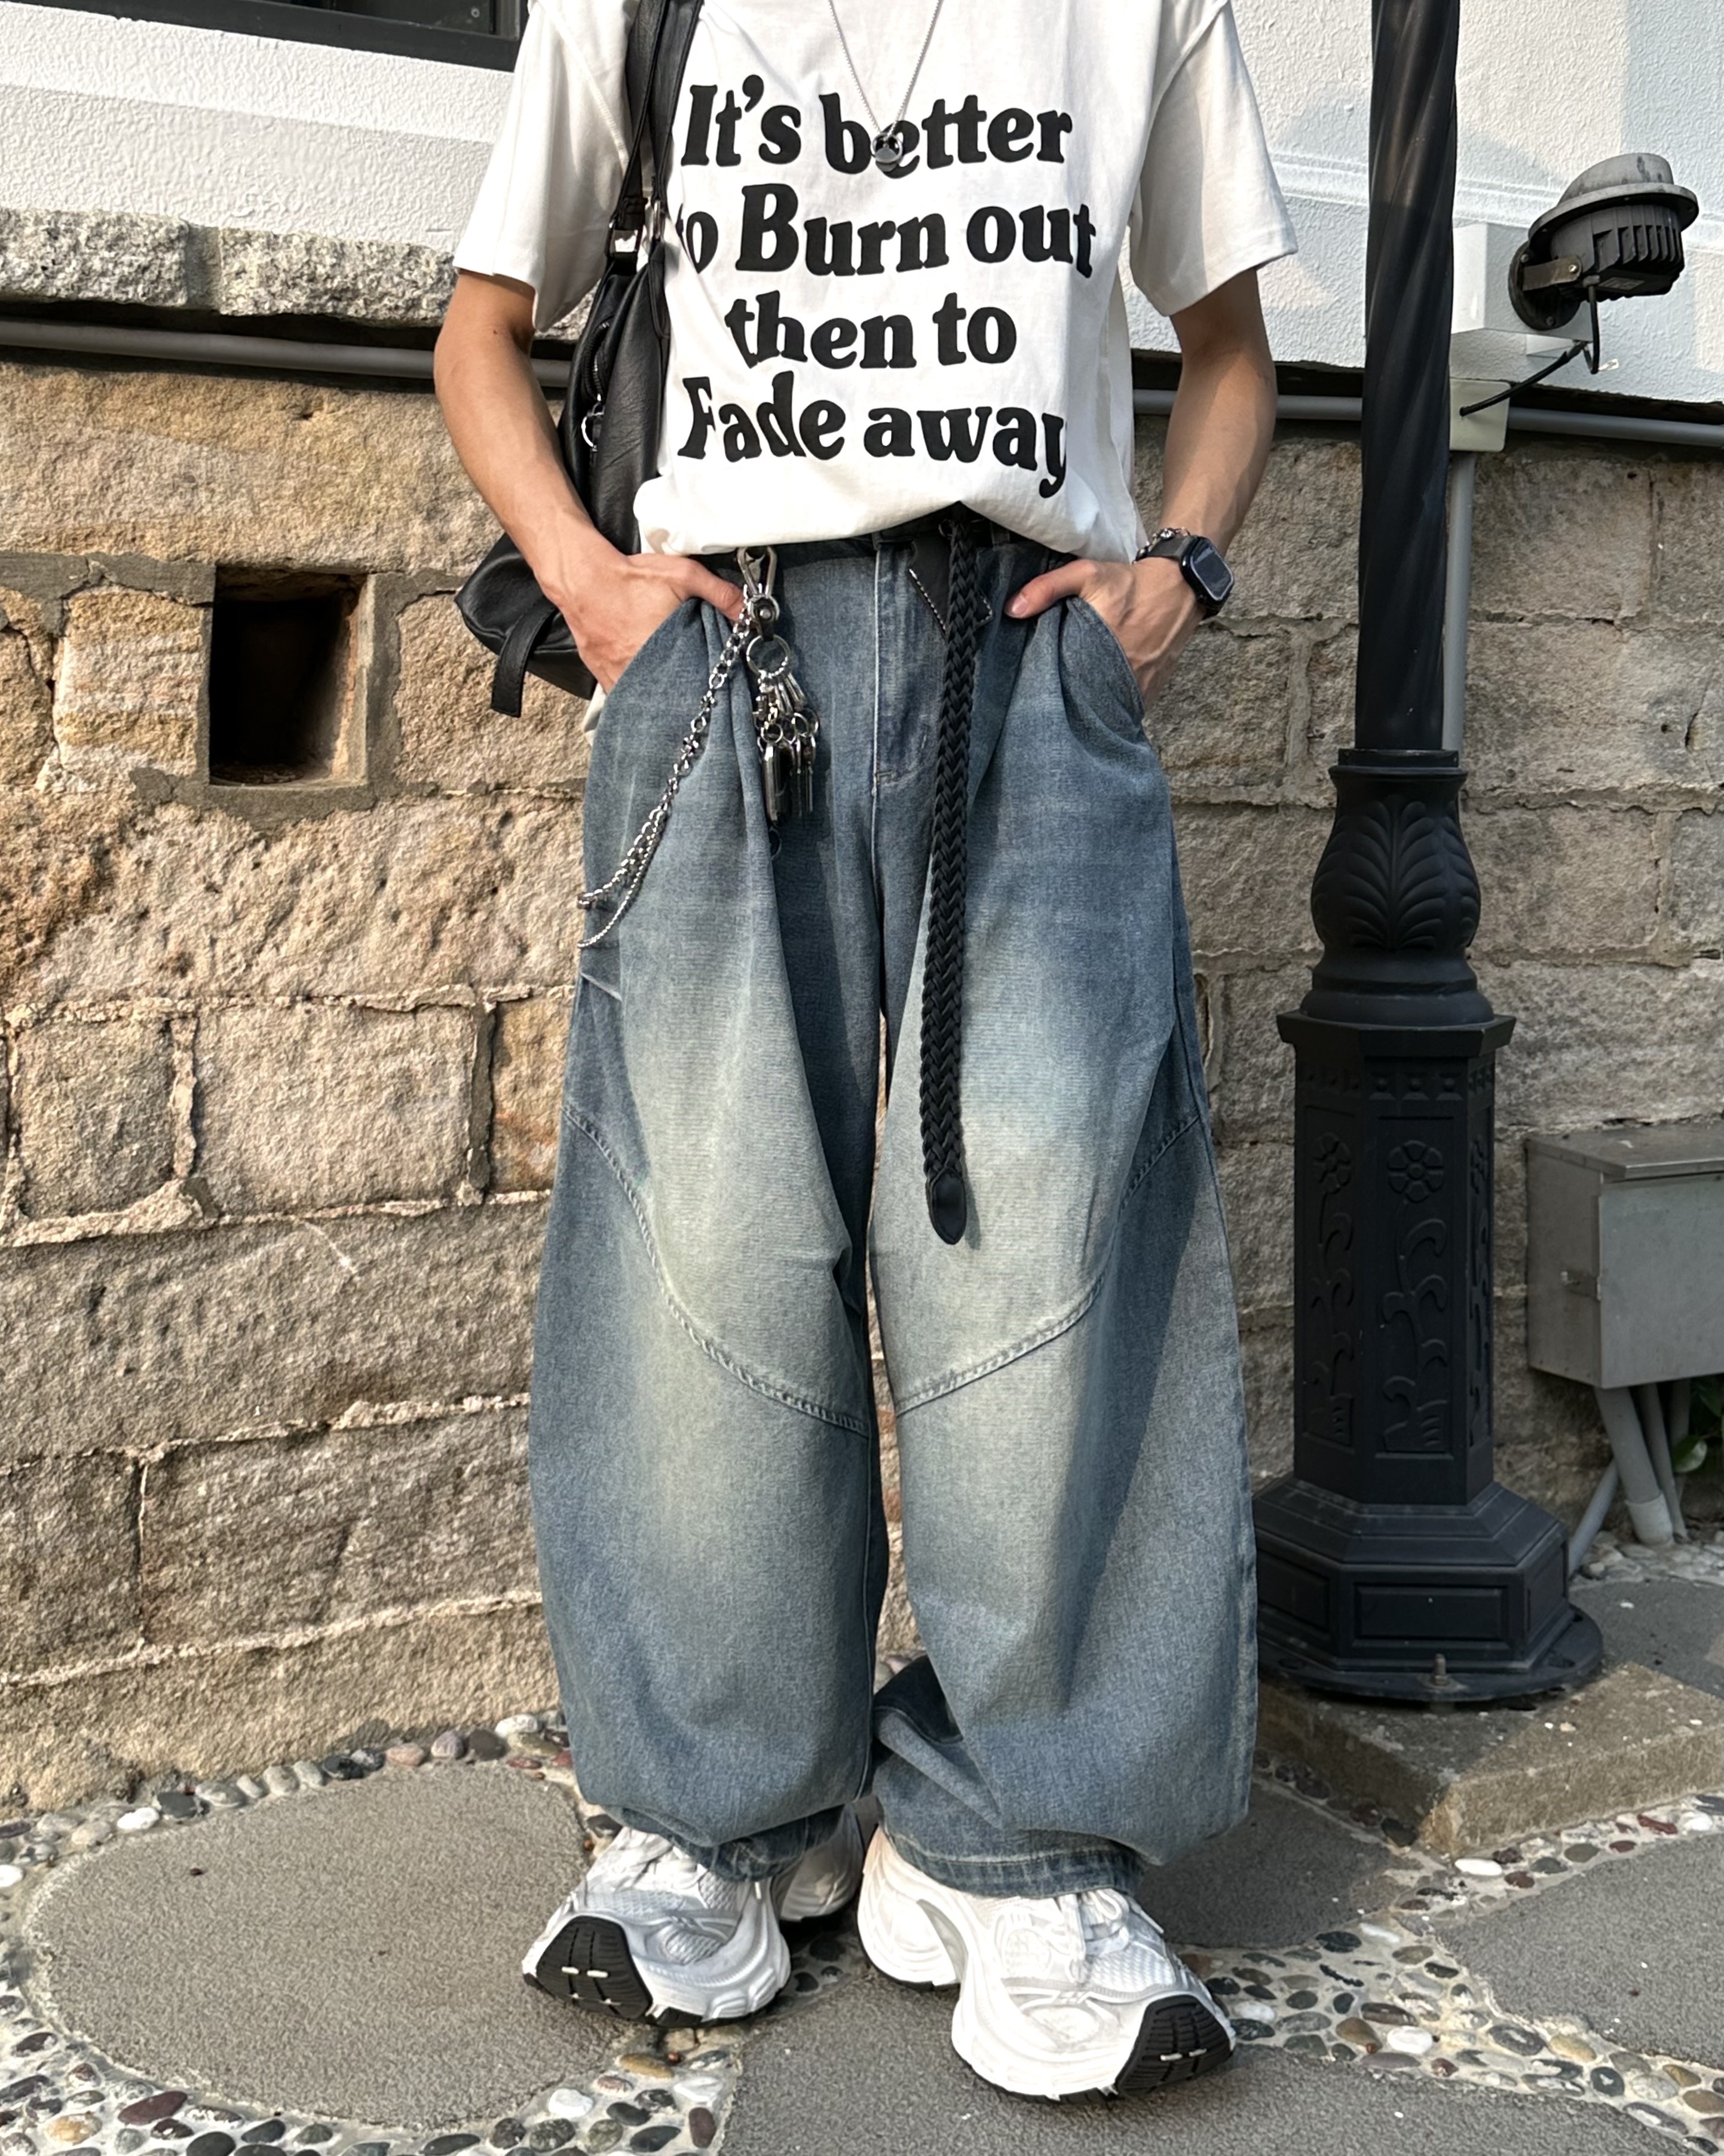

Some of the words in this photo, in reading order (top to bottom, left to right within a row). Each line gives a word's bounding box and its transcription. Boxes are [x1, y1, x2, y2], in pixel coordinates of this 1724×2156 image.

[680, 74, 802, 167] It's
[818, 92, 1073, 179] better
[734, 183, 950, 276] Burn
[966, 204, 1097, 279] out
[724, 289, 917, 369] then
[932, 292, 1017, 366] to
[676, 370, 847, 463] Fade
[862, 406, 1067, 500] away
